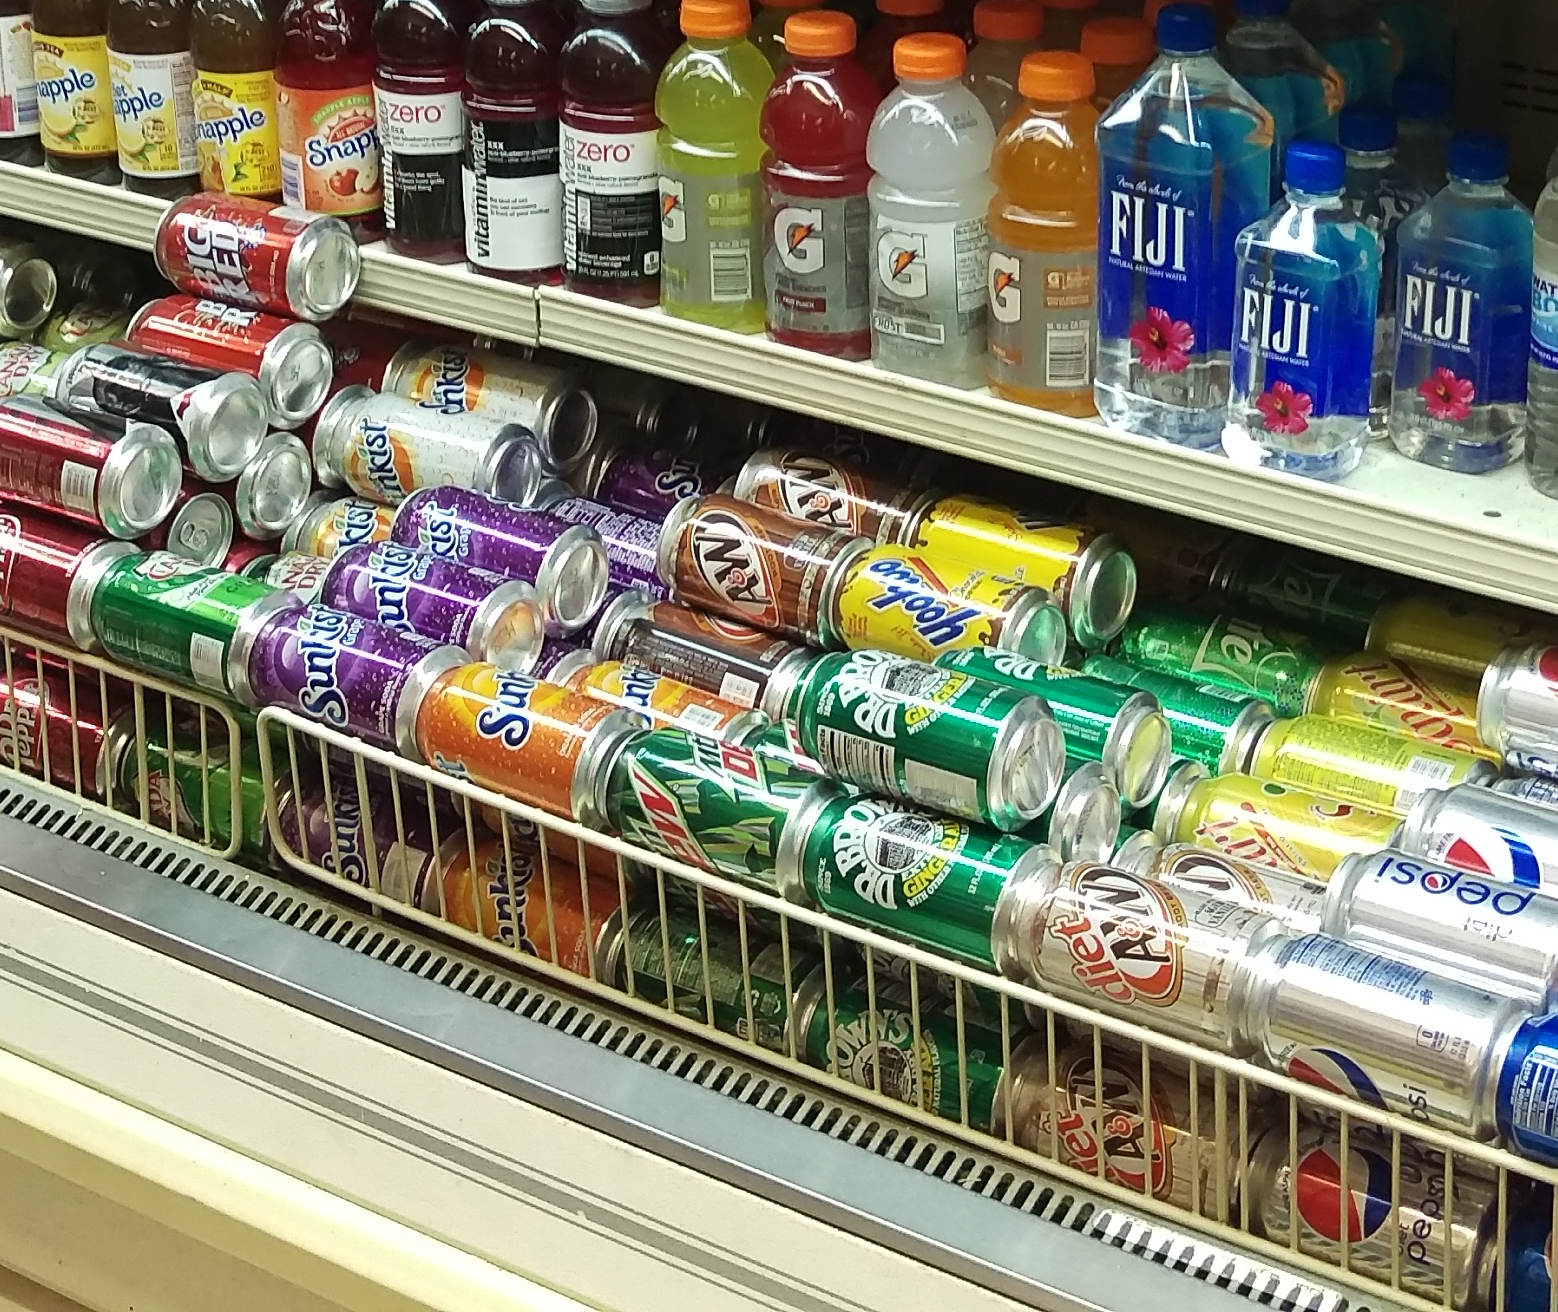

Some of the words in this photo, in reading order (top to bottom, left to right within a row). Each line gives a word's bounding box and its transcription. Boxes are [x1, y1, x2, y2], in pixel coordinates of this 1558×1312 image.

[37, 69, 95, 103] napple
[114, 88, 164, 122] apple
[389, 103, 443, 125] zero
[308, 127, 379, 167] Snapp
[577, 140, 632, 164] zero
[470, 121, 490, 258] vitaminwater
[184, 221, 213, 297] BIG
[210, 218, 240, 309] RED
[774, 206, 825, 274] G
[877, 230, 928, 299] G
[1110, 190, 1188, 272] FIJI
[988, 251, 1021, 323] G
[1108, 256, 1134, 271] NATURAL
[1165, 268, 1187, 282] WATER
[1240, 286, 1312, 359] FIJI
[1404, 274, 1474, 345] FIJI
[456, 526, 472, 556] Grap
[694, 526, 773, 607] A&W
[377, 542, 418, 634] unkist
[299, 603, 349, 727] Sunkist
[342, 617, 365, 646] Grape
[1376, 855, 1538, 918] pepsi
[1050, 911, 1138, 1006] diet
[1075, 887, 1170, 965] A&W
